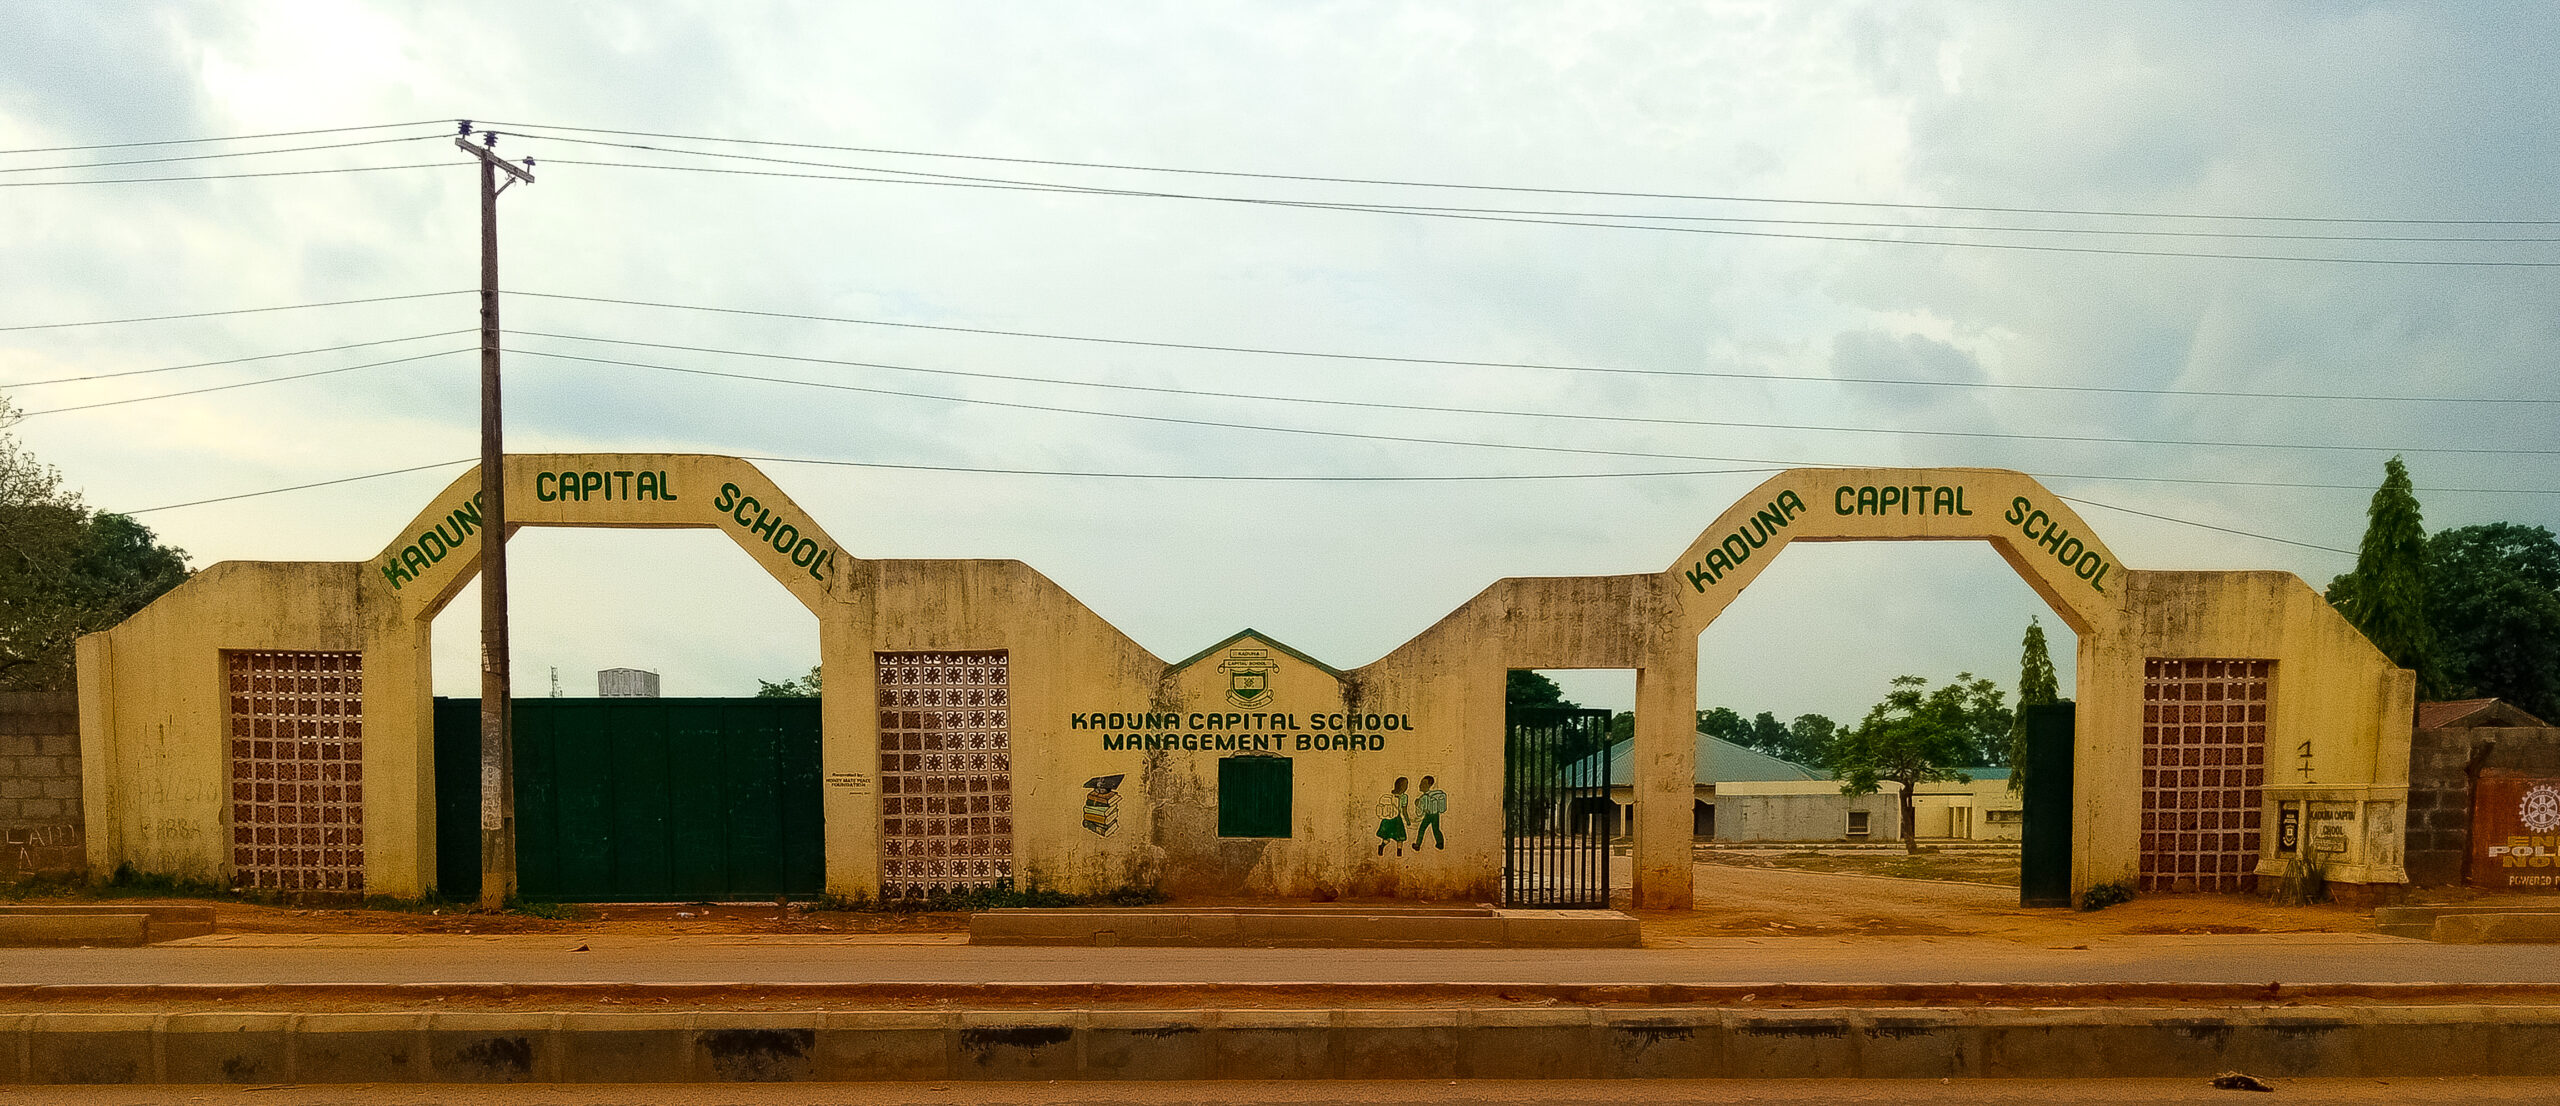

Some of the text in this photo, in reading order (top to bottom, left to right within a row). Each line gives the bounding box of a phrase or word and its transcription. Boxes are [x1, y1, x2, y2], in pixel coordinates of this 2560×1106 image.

[536, 471, 677, 502] CAPITAL
[713, 482, 834, 582] SCHOOL
[1685, 485, 2111, 594] KADUNA CAPITAL SCHOOL
[1071, 712, 1414, 731] KADUNA CAPITAL SCHOOL
[1103, 734, 1385, 750] MANAGEMENT BOARD
[2508, 836, 2560, 846] EN
[2503, 856, 2560, 867] NO
